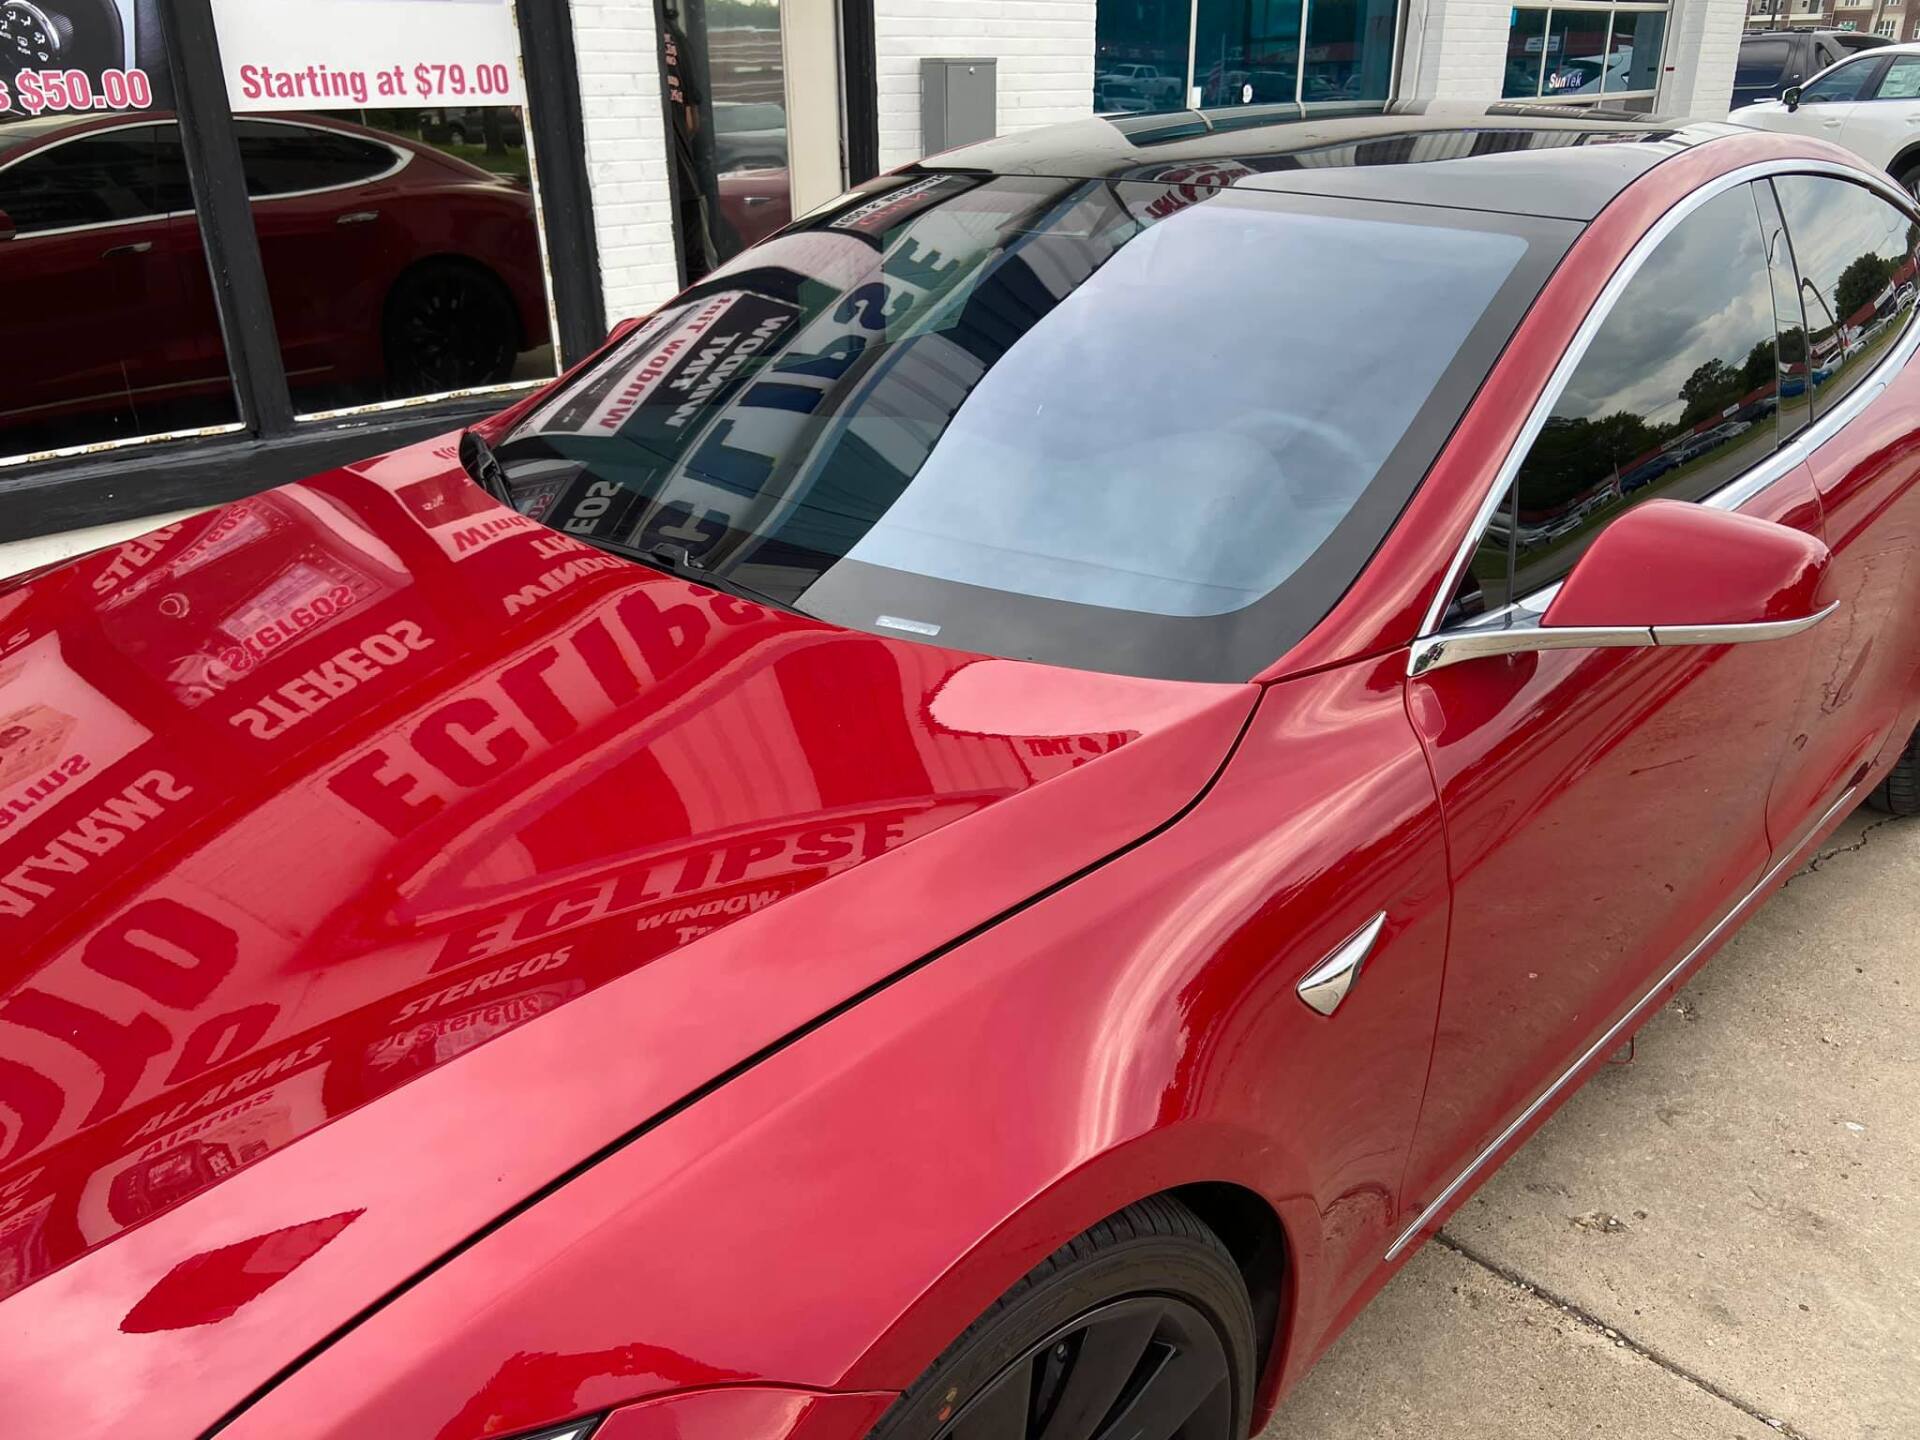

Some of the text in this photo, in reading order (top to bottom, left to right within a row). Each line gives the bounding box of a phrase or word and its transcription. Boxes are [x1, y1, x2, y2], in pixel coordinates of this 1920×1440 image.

[15, 68, 152, 115] $50.00
[240, 62, 510, 103] Starting at $79.00
[1549, 72, 1583, 89] SunTek
[636, 890, 780, 931] WINDOW
[390, 944, 575, 1026] STEREOS
[121, 1036, 331, 1148] ALARMS
